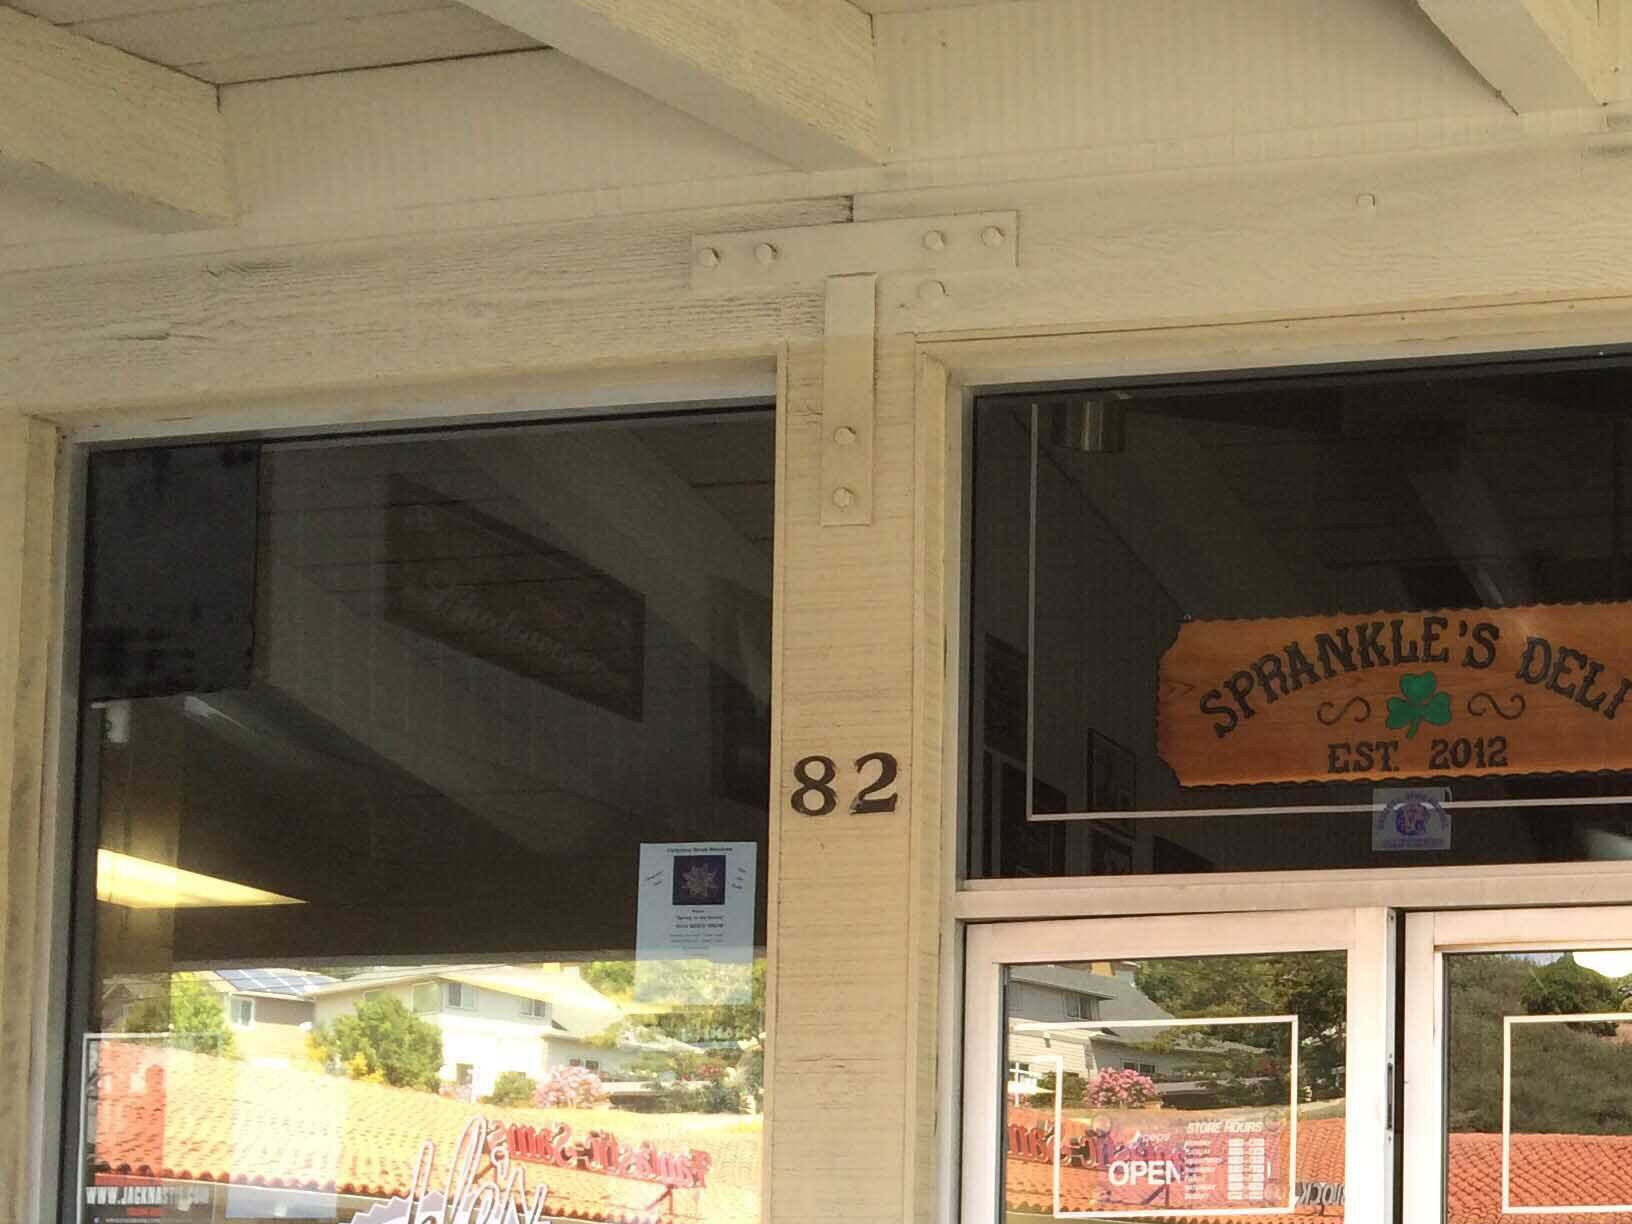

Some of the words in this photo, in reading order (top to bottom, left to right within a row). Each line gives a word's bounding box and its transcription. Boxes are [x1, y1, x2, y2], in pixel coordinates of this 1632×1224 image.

[1200, 616, 1500, 739] SPRANKLE'S
[1327, 740, 1400, 774] EST.
[1429, 736, 1509, 770] 2012
[790, 751, 899, 817] 82
[1186, 1121, 1222, 1134] STORE
[1224, 1121, 1264, 1133] HOURS
[1108, 1160, 1181, 1185] OPEN
